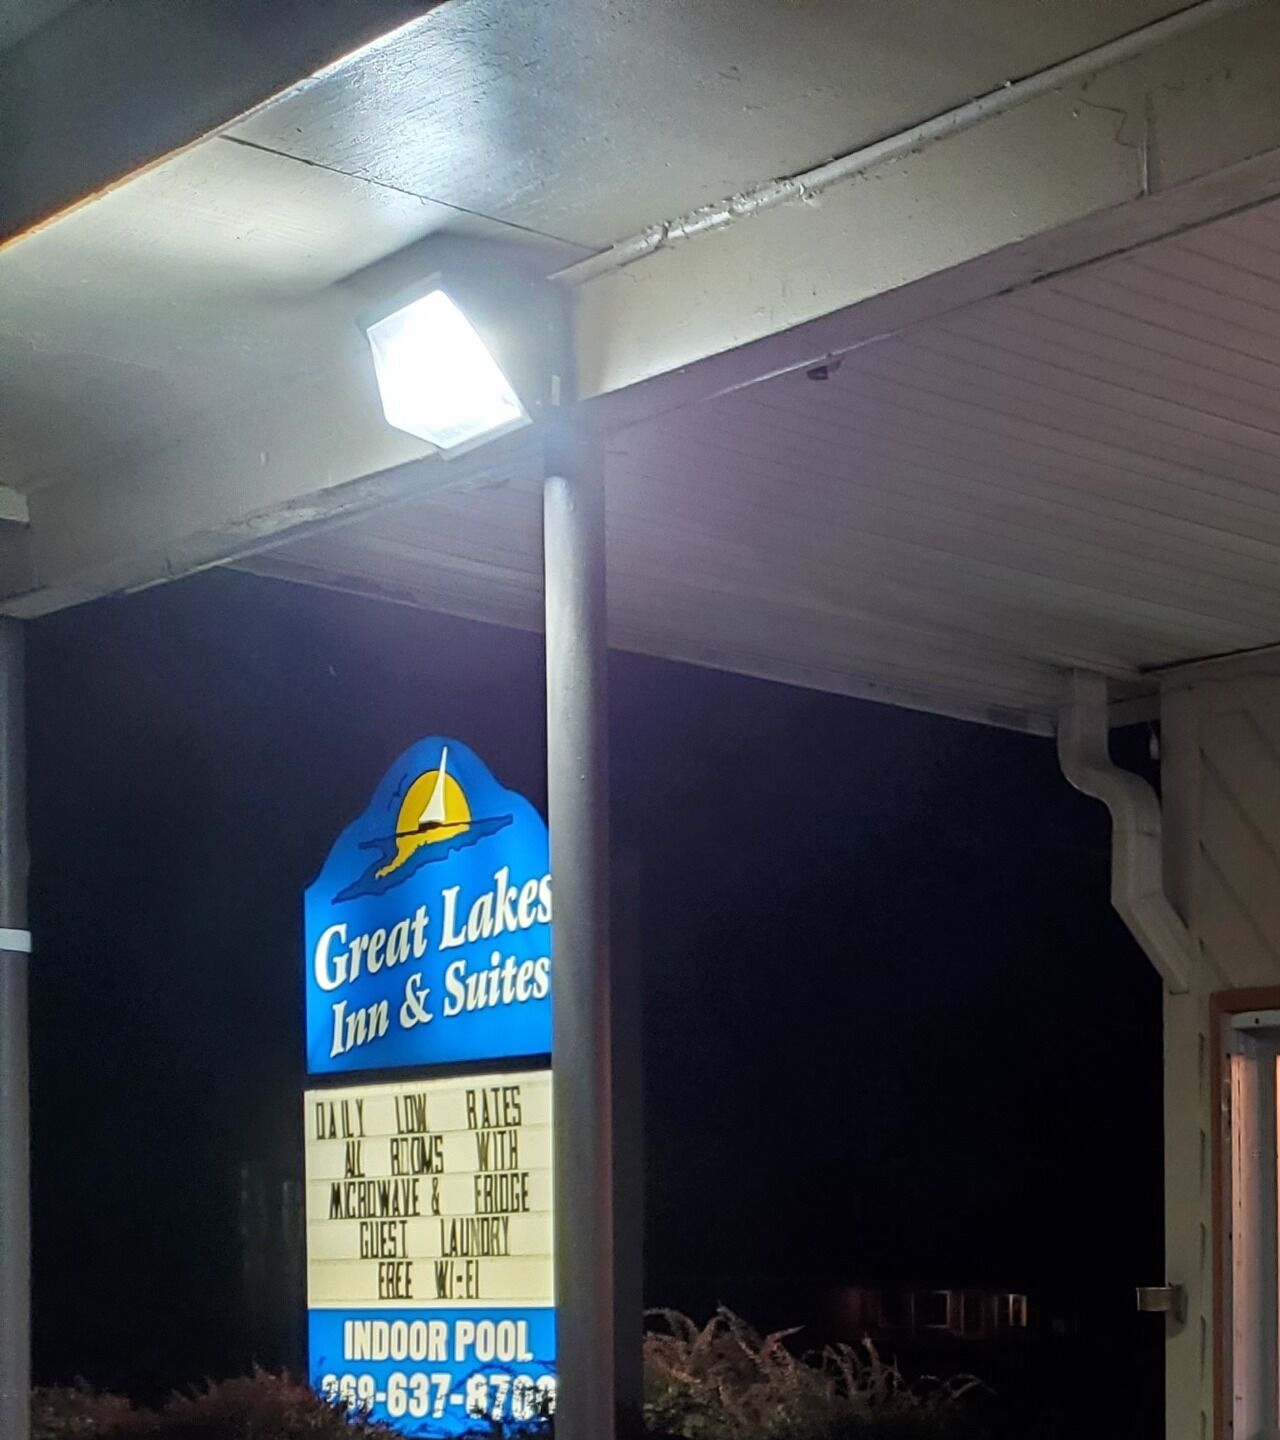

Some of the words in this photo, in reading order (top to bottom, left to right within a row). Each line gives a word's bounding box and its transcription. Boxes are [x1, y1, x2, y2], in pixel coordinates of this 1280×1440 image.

[314, 905, 431, 991] Great
[439, 866, 553, 951] Lakes
[330, 999, 389, 1059] Inn
[399, 972, 433, 1029] &
[443, 951, 550, 1017] Suites
[316, 1099, 366, 1140] DAILY
[394, 1093, 429, 1134] LOW
[465, 1085, 522, 1130] RATES
[344, 1140, 365, 1178] ALL
[390, 1135, 444, 1176] ROOMS
[476, 1130, 518, 1172] WITH
[329, 1178, 420, 1220] MICROWAVE
[432, 1176, 440, 1216] &
[474, 1172, 530, 1214] FRIDGE
[359, 1219, 408, 1259] GUEST
[440, 1216, 510, 1257] LAUNDRY
[378, 1261, 413, 1300] FREE
[434, 1259, 480, 1300] WI-FI
[344, 1320, 447, 1362] INDOOR
[454, 1320, 534, 1362] POOL
